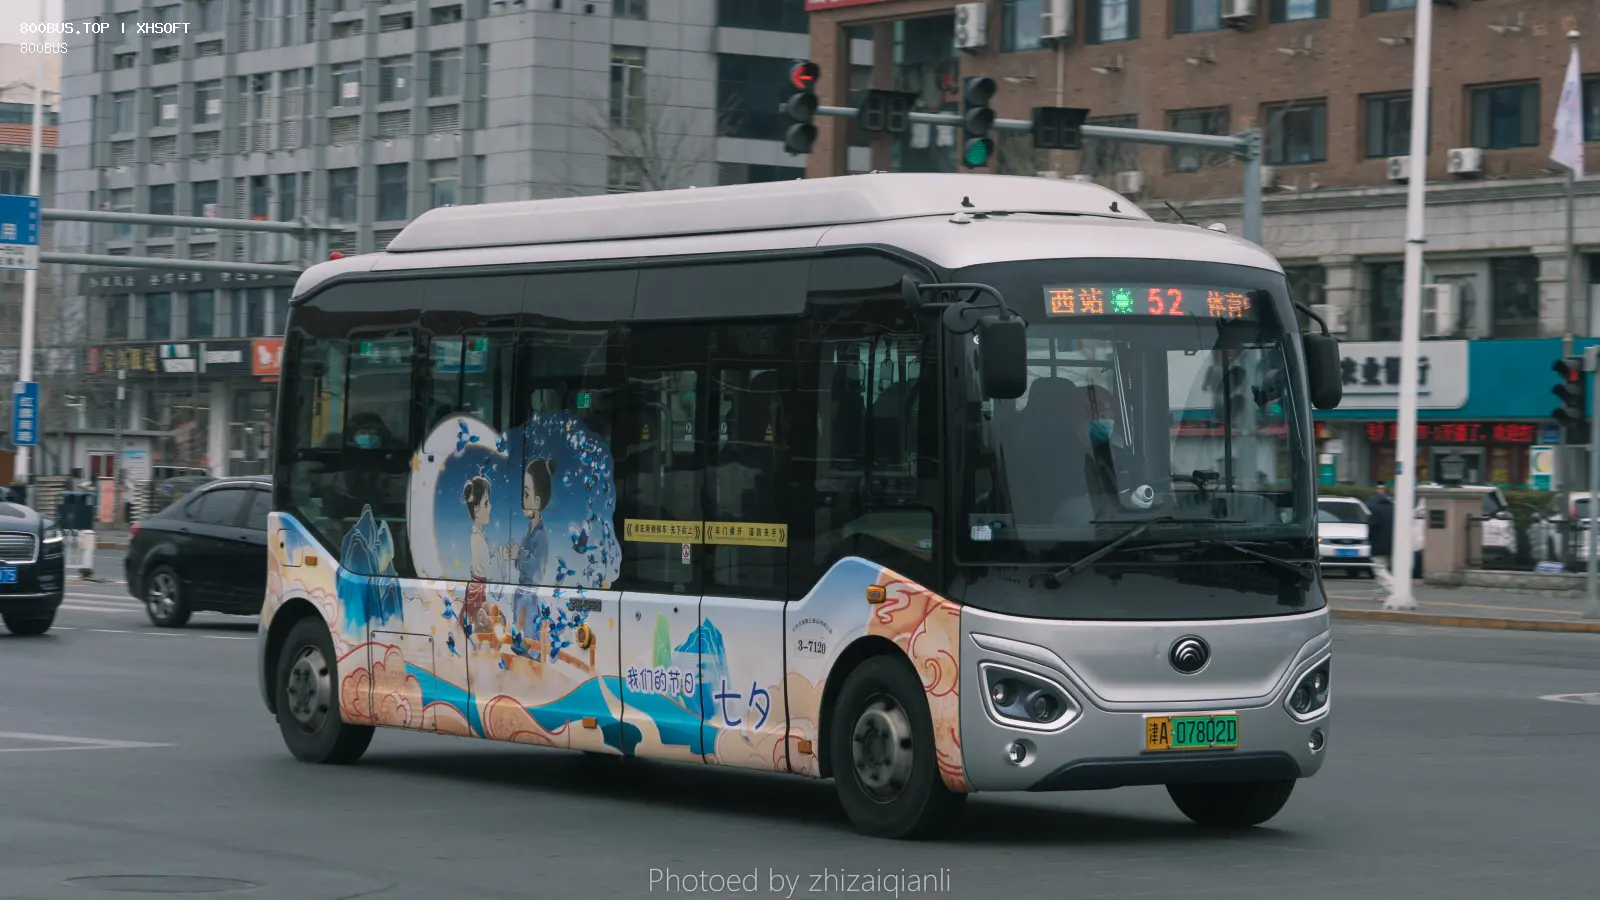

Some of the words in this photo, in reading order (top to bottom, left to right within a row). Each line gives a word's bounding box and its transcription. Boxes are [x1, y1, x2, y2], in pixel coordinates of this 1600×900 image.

[1049, 289, 1104, 314] 西站
[1147, 288, 1184, 315] 52
[1206, 290, 1252, 318] 体育
[670, 525, 693, 535] 先下后上
[797, 639, 827, 655] 3-7120
[627, 666, 694, 694] 我们的节日
[714, 679, 770, 730] 七夕
